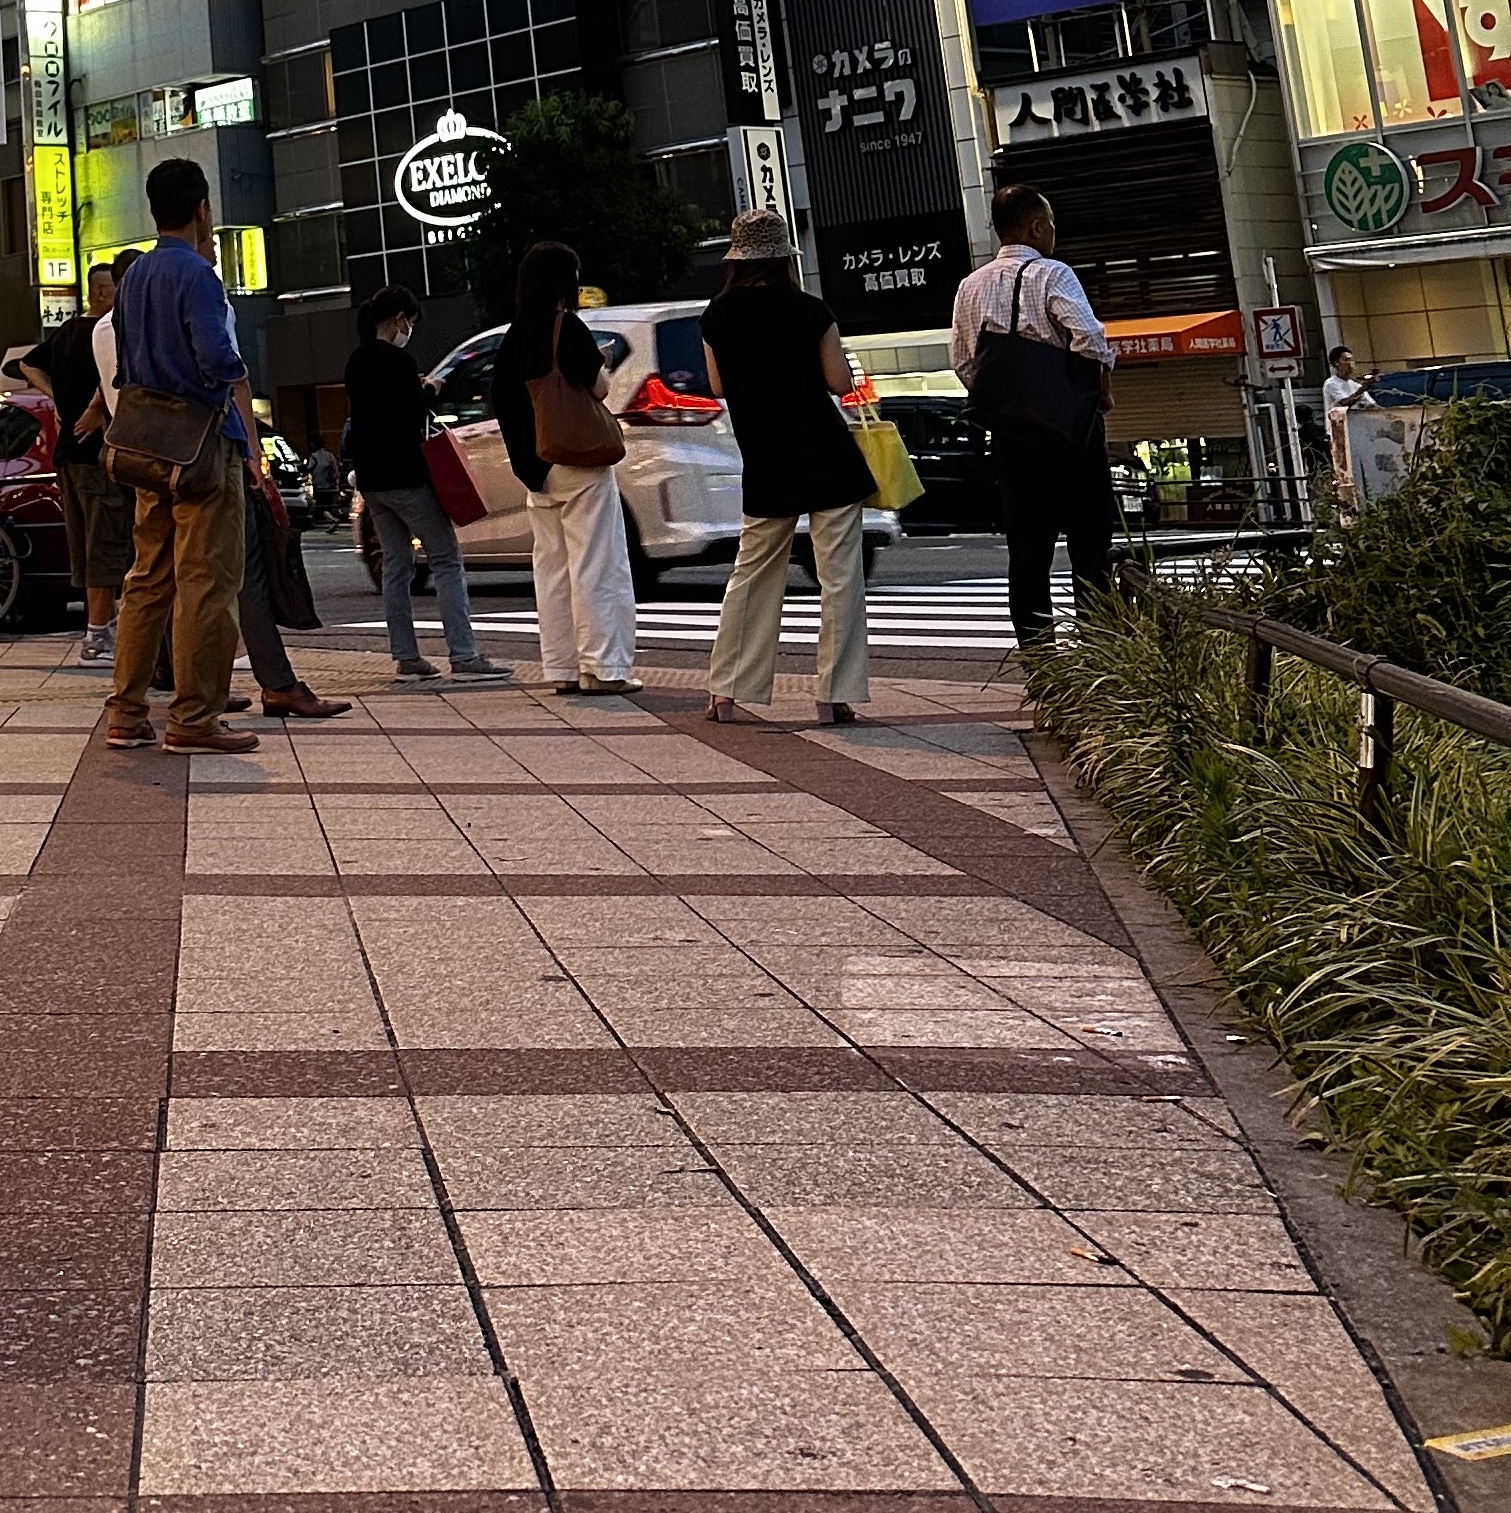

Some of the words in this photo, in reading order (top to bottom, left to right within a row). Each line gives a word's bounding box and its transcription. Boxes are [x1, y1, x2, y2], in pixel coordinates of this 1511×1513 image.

[832, 41, 912, 78] カメラの
[817, 78, 916, 133] ナニワ
[859, 137, 891, 154] since
[894, 131, 923, 148] 1947
[54, 153, 68, 224] ストレッチ
[409, 150, 489, 191] EXELC
[1418, 144, 1511, 215] ス
[41, 191, 53, 235] 専門店
[48, 262, 68, 278] 1F
[842, 241, 942, 271] カメラ・レンズ
[863, 268, 926, 292] 高価買取
